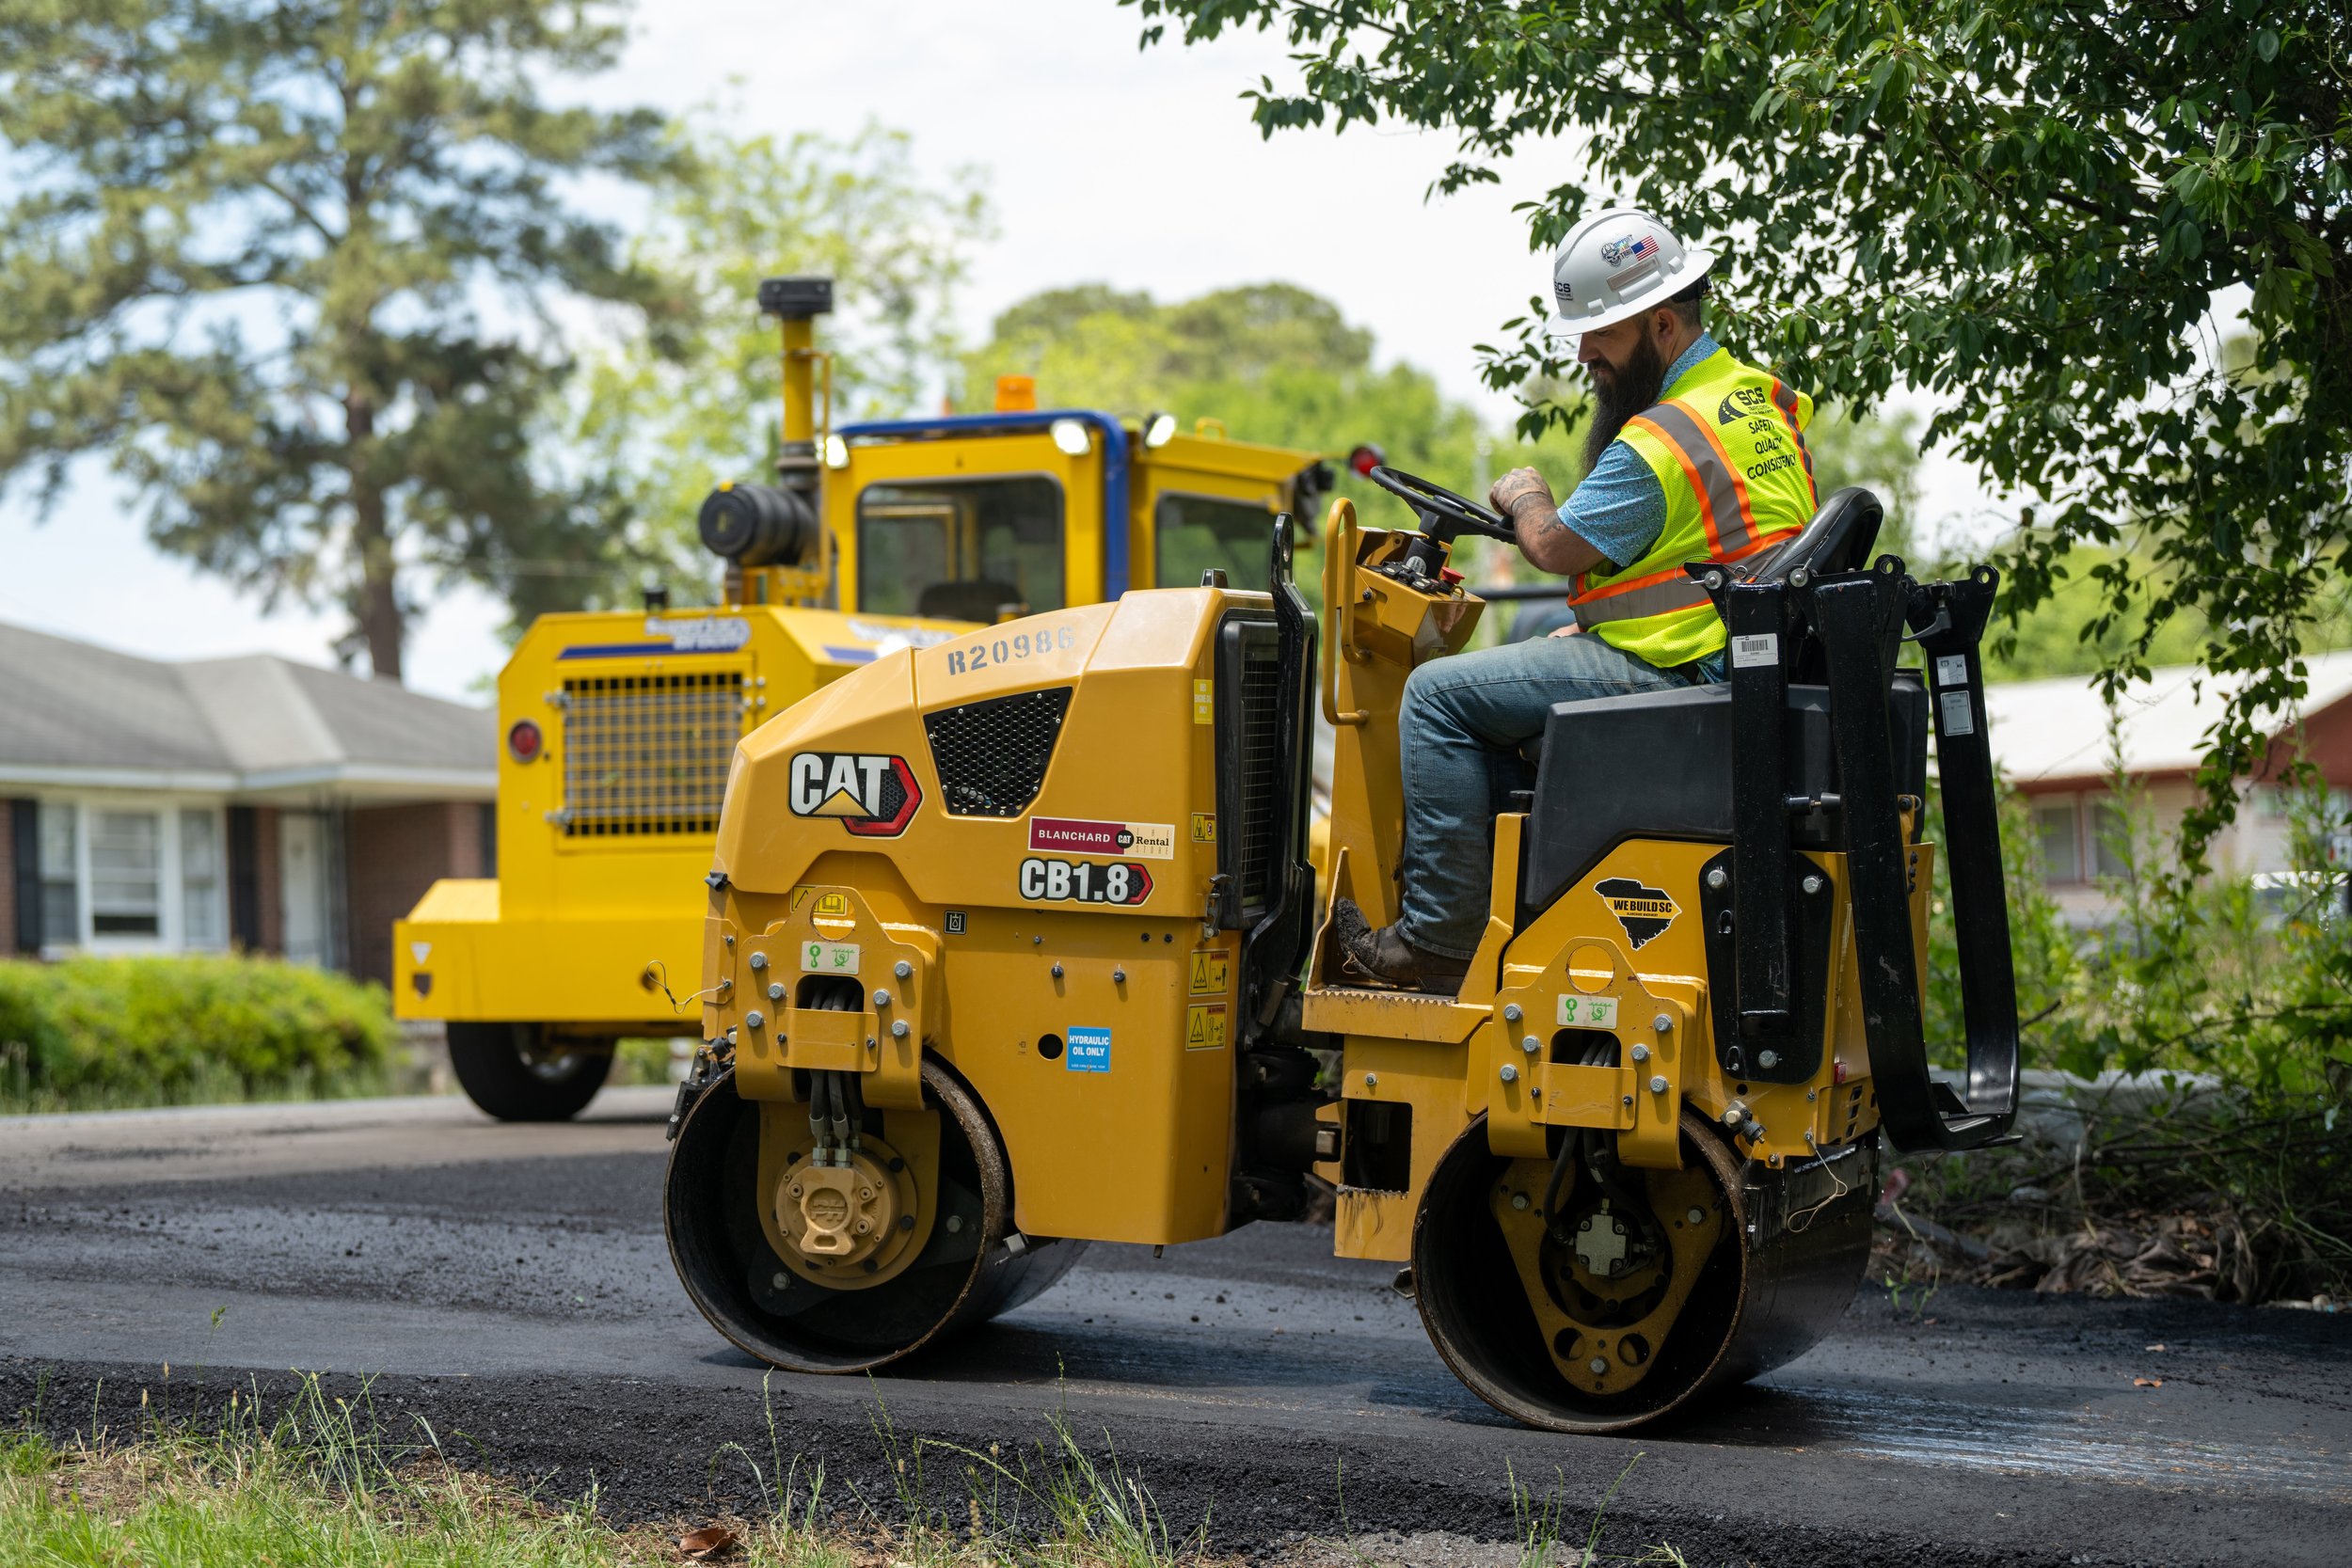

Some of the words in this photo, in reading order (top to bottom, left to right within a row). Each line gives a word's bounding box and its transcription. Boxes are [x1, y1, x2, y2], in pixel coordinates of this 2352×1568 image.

[1735, 387, 1766, 405] SCS
[1755, 436, 1783, 454] QUALTY
[947, 626, 1075, 676] R20986
[790, 753, 890, 816] CAT
[1039, 830, 1111, 843] BLANCHARD
[1118, 834, 1132, 844] CAT
[1136, 836, 1169, 847] Rental
[1021, 859, 1129, 902] CB1.8
[1613, 899, 1629, 911] WE
[1629, 900, 1658, 911] BUILD
[1659, 902, 1672, 912] SC
[1069, 1035, 1109, 1046] HYDRAULIC
[1073, 1046, 1085, 1055] OIL
[1086, 1047, 1105, 1056] ONLY
